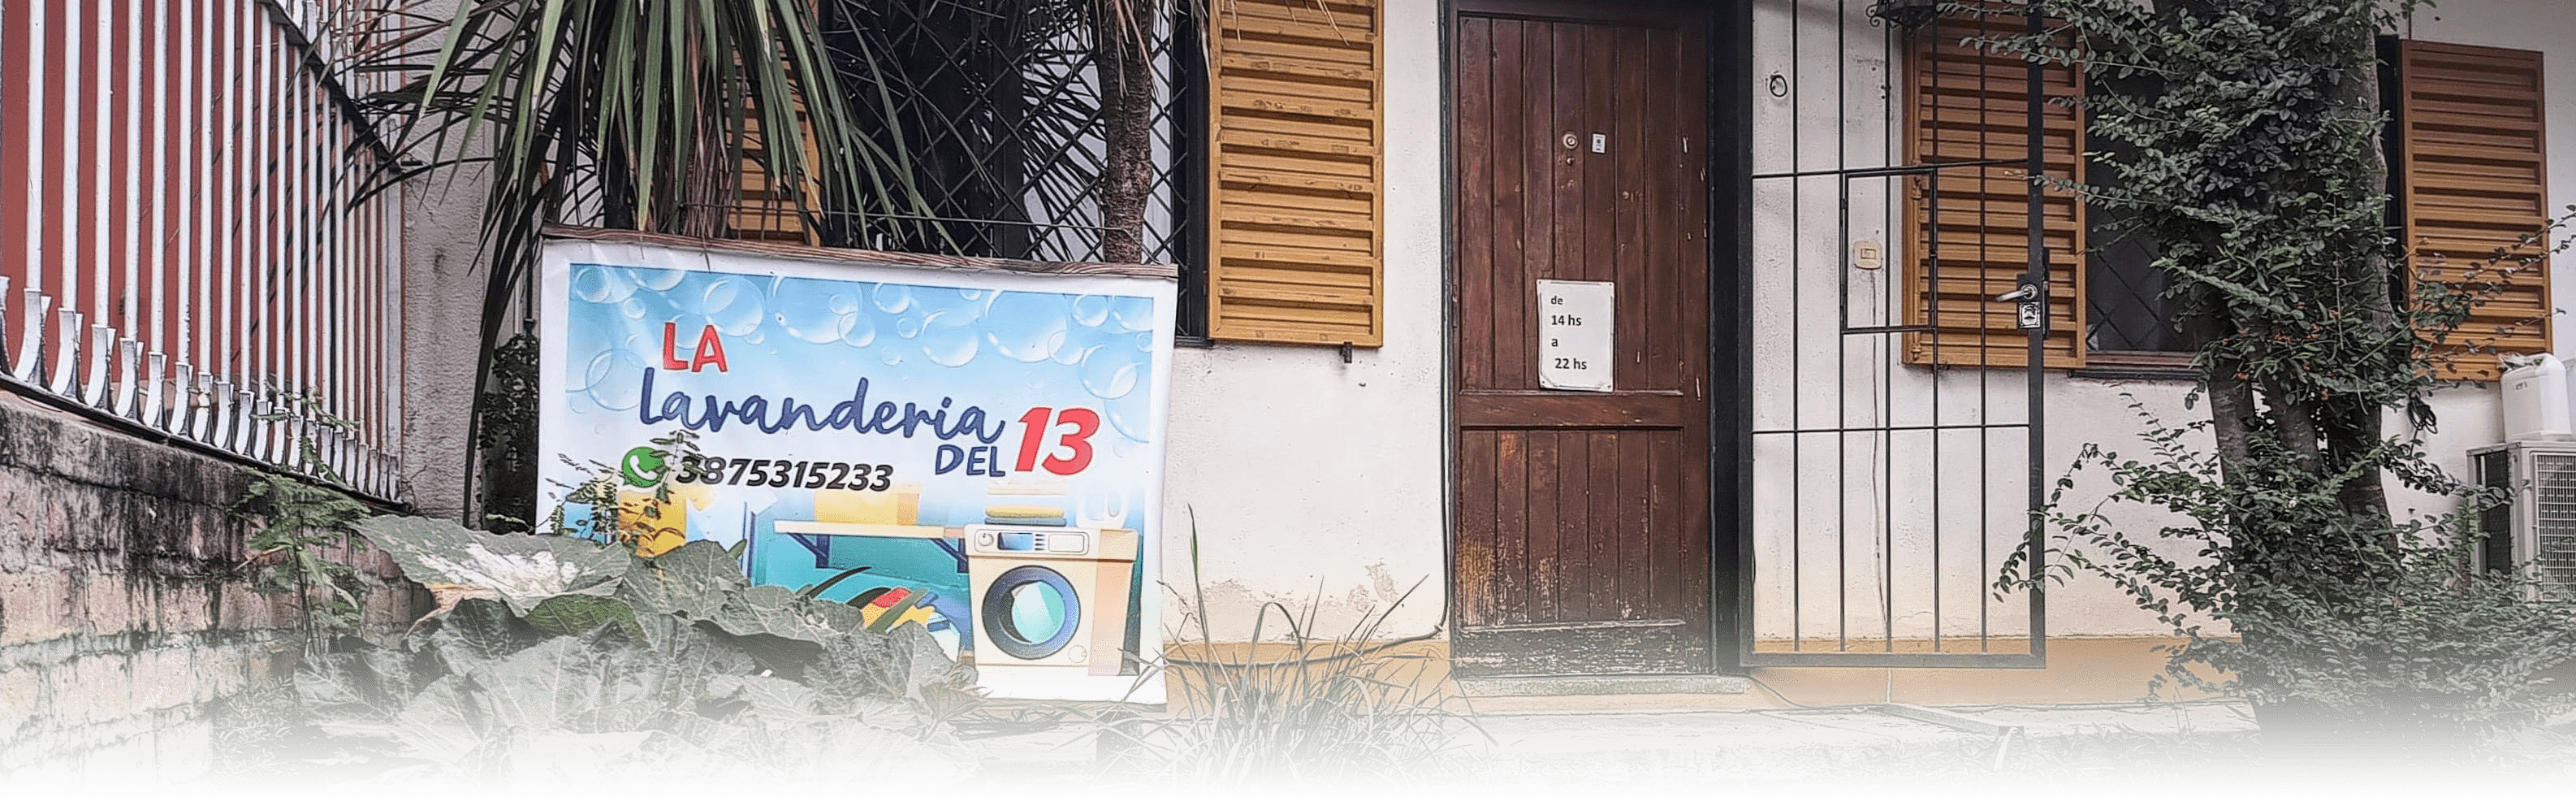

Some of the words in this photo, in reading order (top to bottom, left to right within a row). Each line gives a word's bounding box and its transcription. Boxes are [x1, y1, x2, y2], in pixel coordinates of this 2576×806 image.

[1550, 295, 1563, 305] de
[1551, 314, 1565, 326] 14
[1568, 314, 1582, 326] hs
[663, 322, 728, 373] LA
[1551, 338, 1558, 347] a
[1554, 358, 1570, 370] 22
[1573, 358, 1588, 370] hs
[935, 444, 1005, 477] DEL
[1014, 406, 1100, 476] 13
[675, 457, 894, 492] 3875315233
